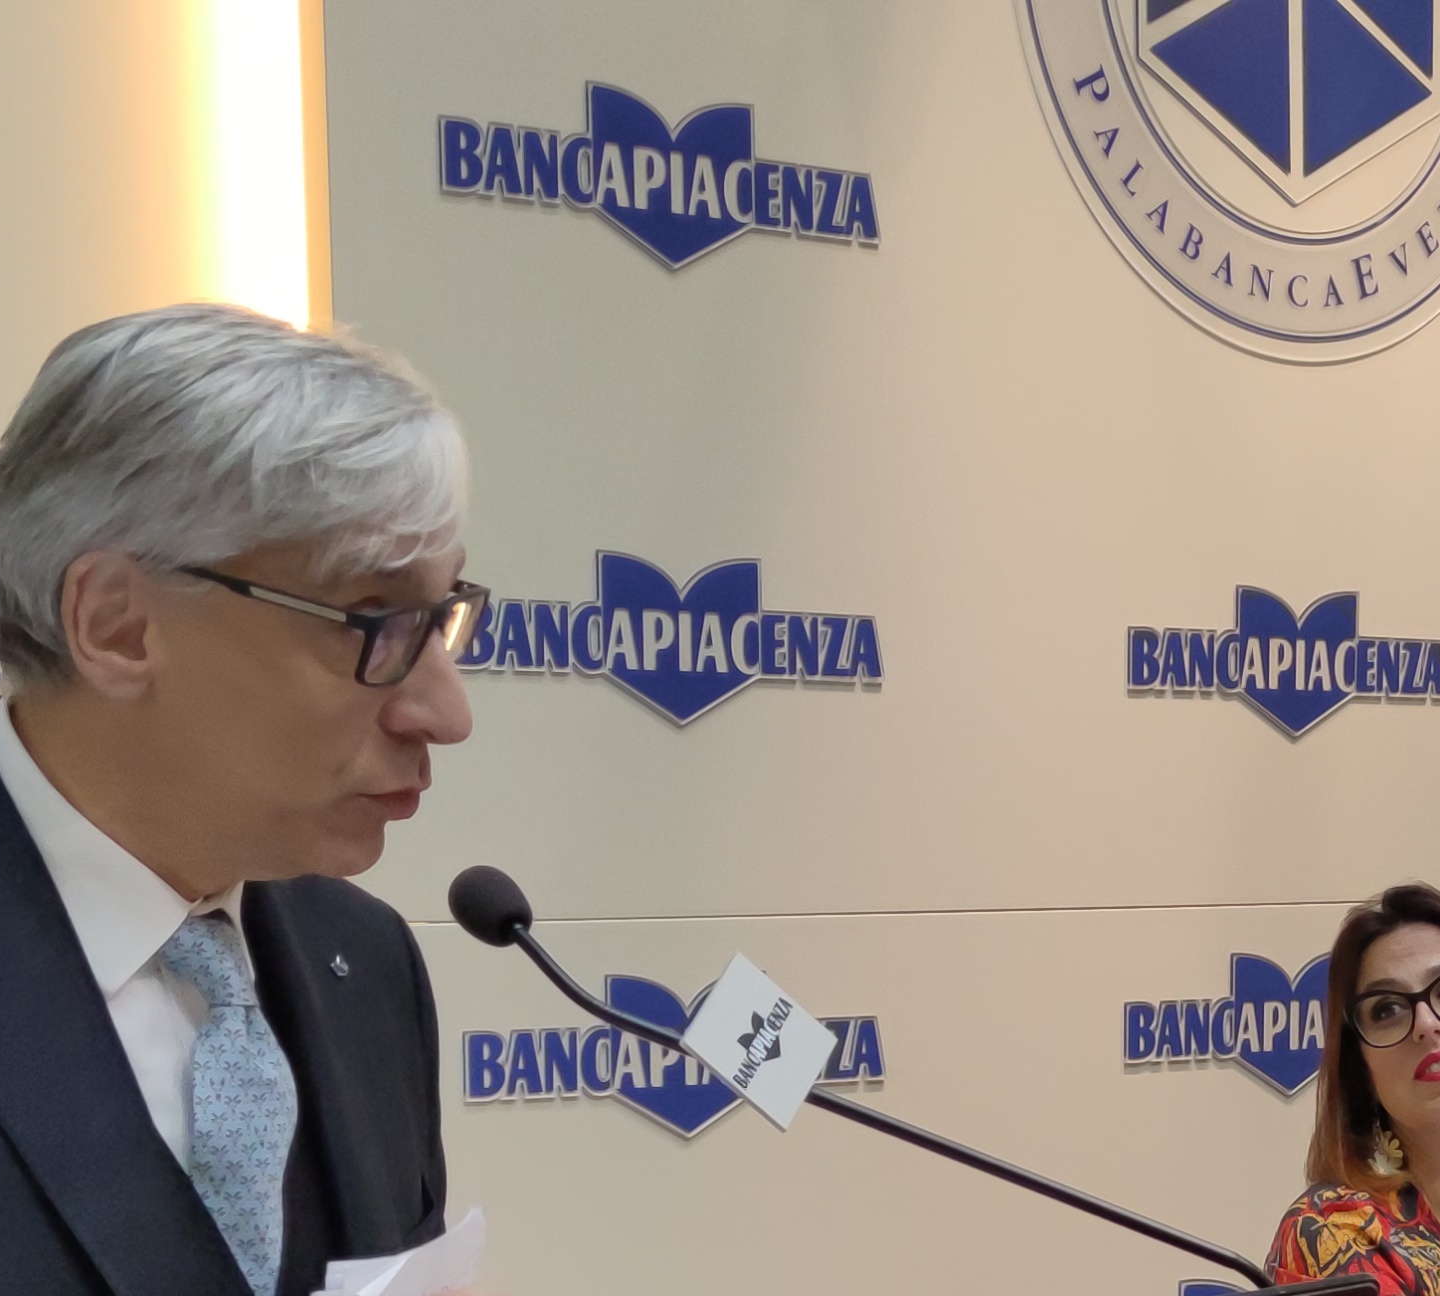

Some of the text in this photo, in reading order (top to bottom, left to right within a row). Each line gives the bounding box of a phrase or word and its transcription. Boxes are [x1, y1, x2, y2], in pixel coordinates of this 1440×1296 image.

[443, 118, 877, 241] BANCAPIACENZA
[455, 601, 881, 680] BANCAPIACENZA
[732, 996, 794, 1091] BANCAPIACENZA
[1127, 999, 1327, 1060] BANCAPIA
